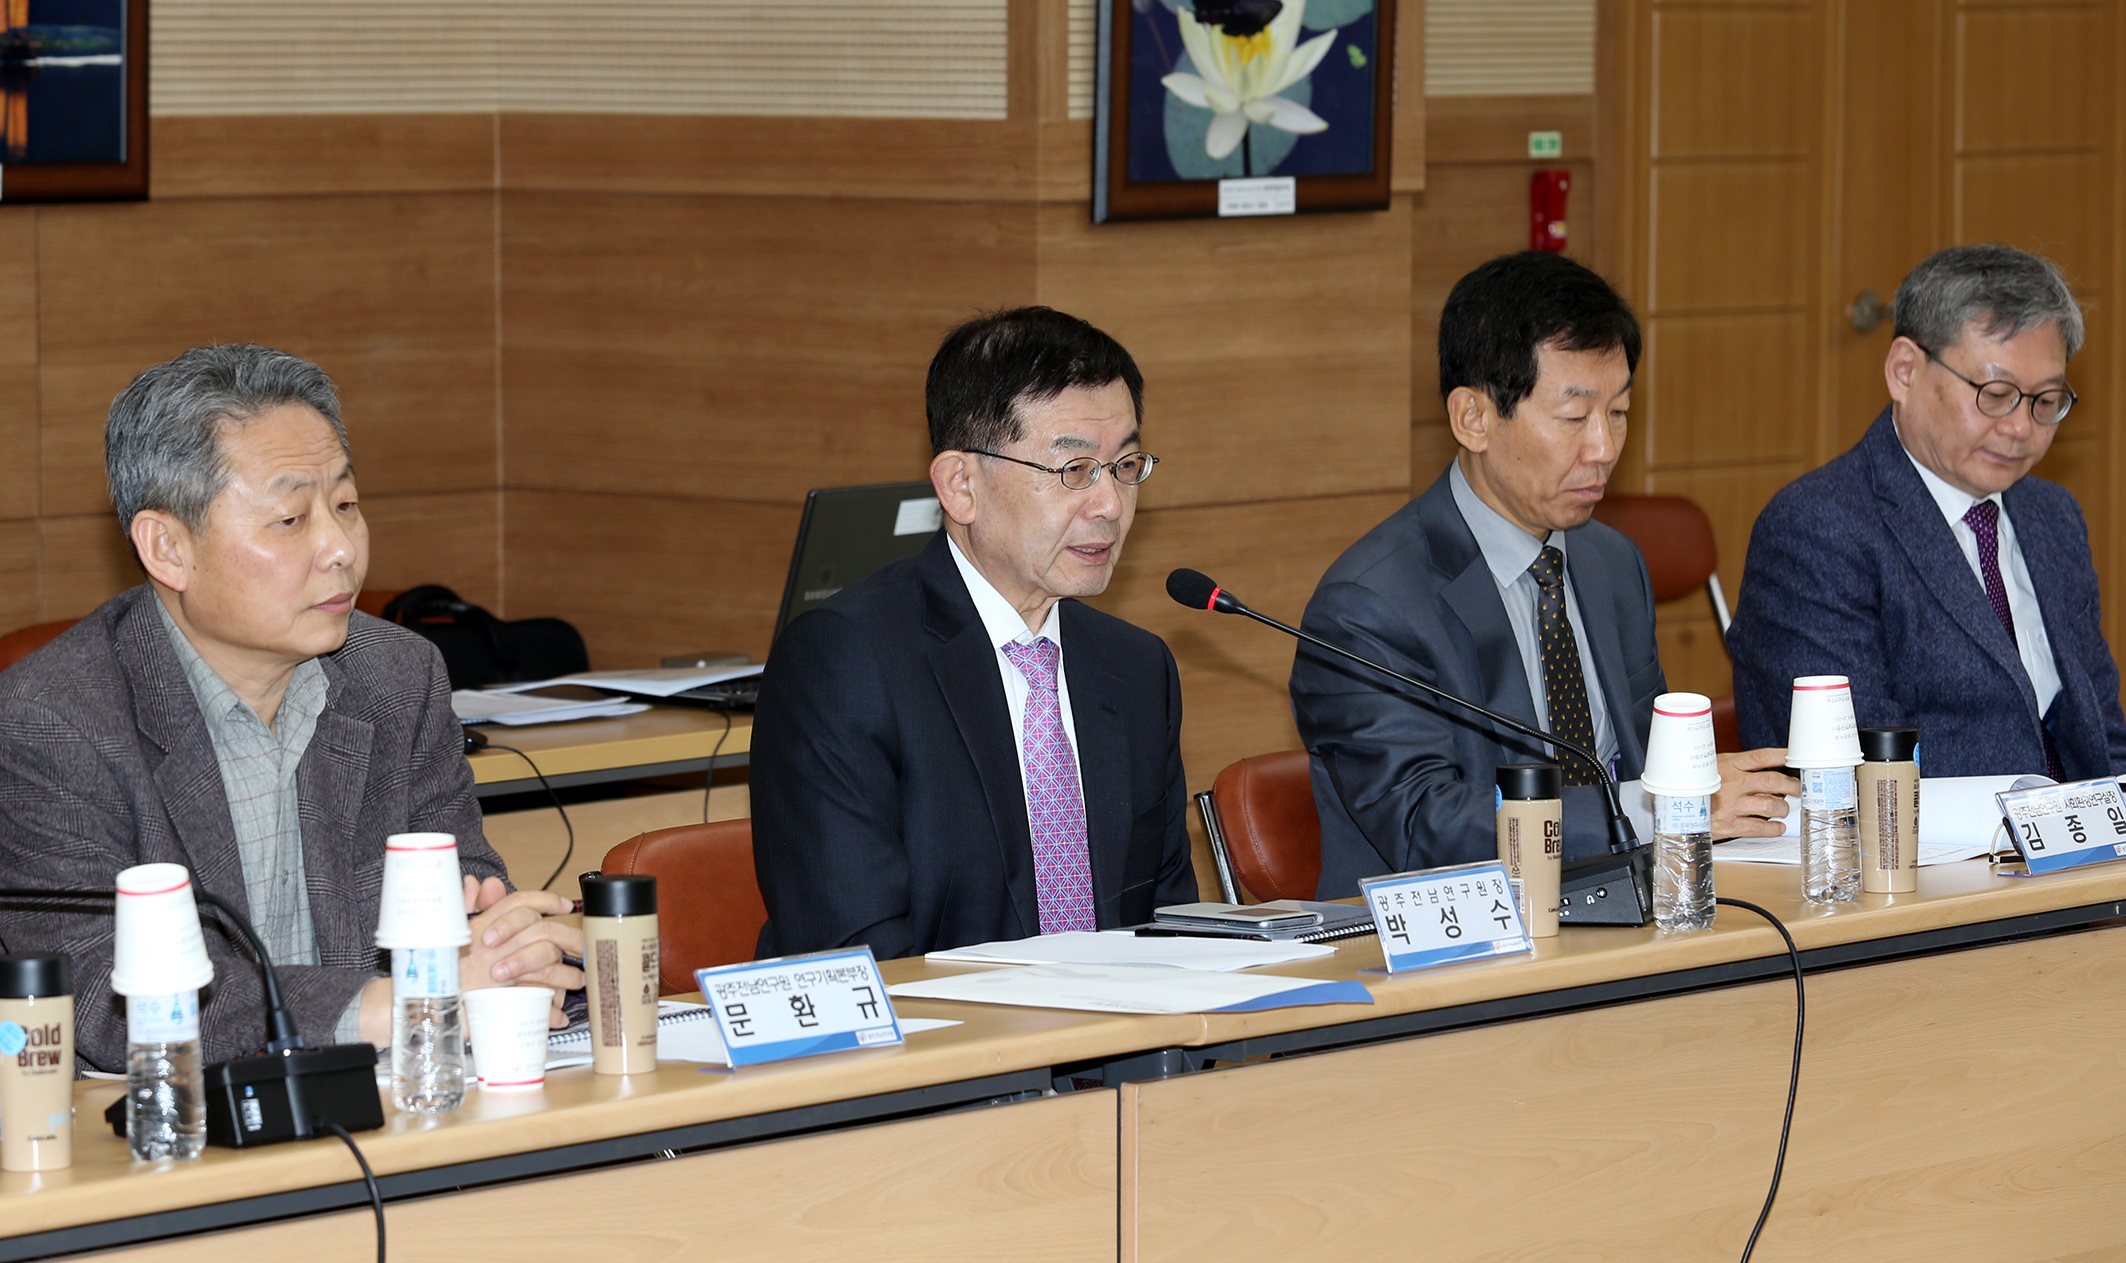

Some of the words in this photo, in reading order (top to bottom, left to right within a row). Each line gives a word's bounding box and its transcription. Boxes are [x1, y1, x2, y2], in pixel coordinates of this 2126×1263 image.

[1671, 800, 1695, 813] 석수
[2013, 800, 2063, 820] 광주전남연구원
[2064, 790, 2118, 810] 사회환경연구실장
[1544, 838, 1562, 854] Bre
[714, 975, 791, 999] 광주전남연구원
[794, 965, 869, 989] 연구기획본부장
[18, 1048, 62, 1067] Brew
